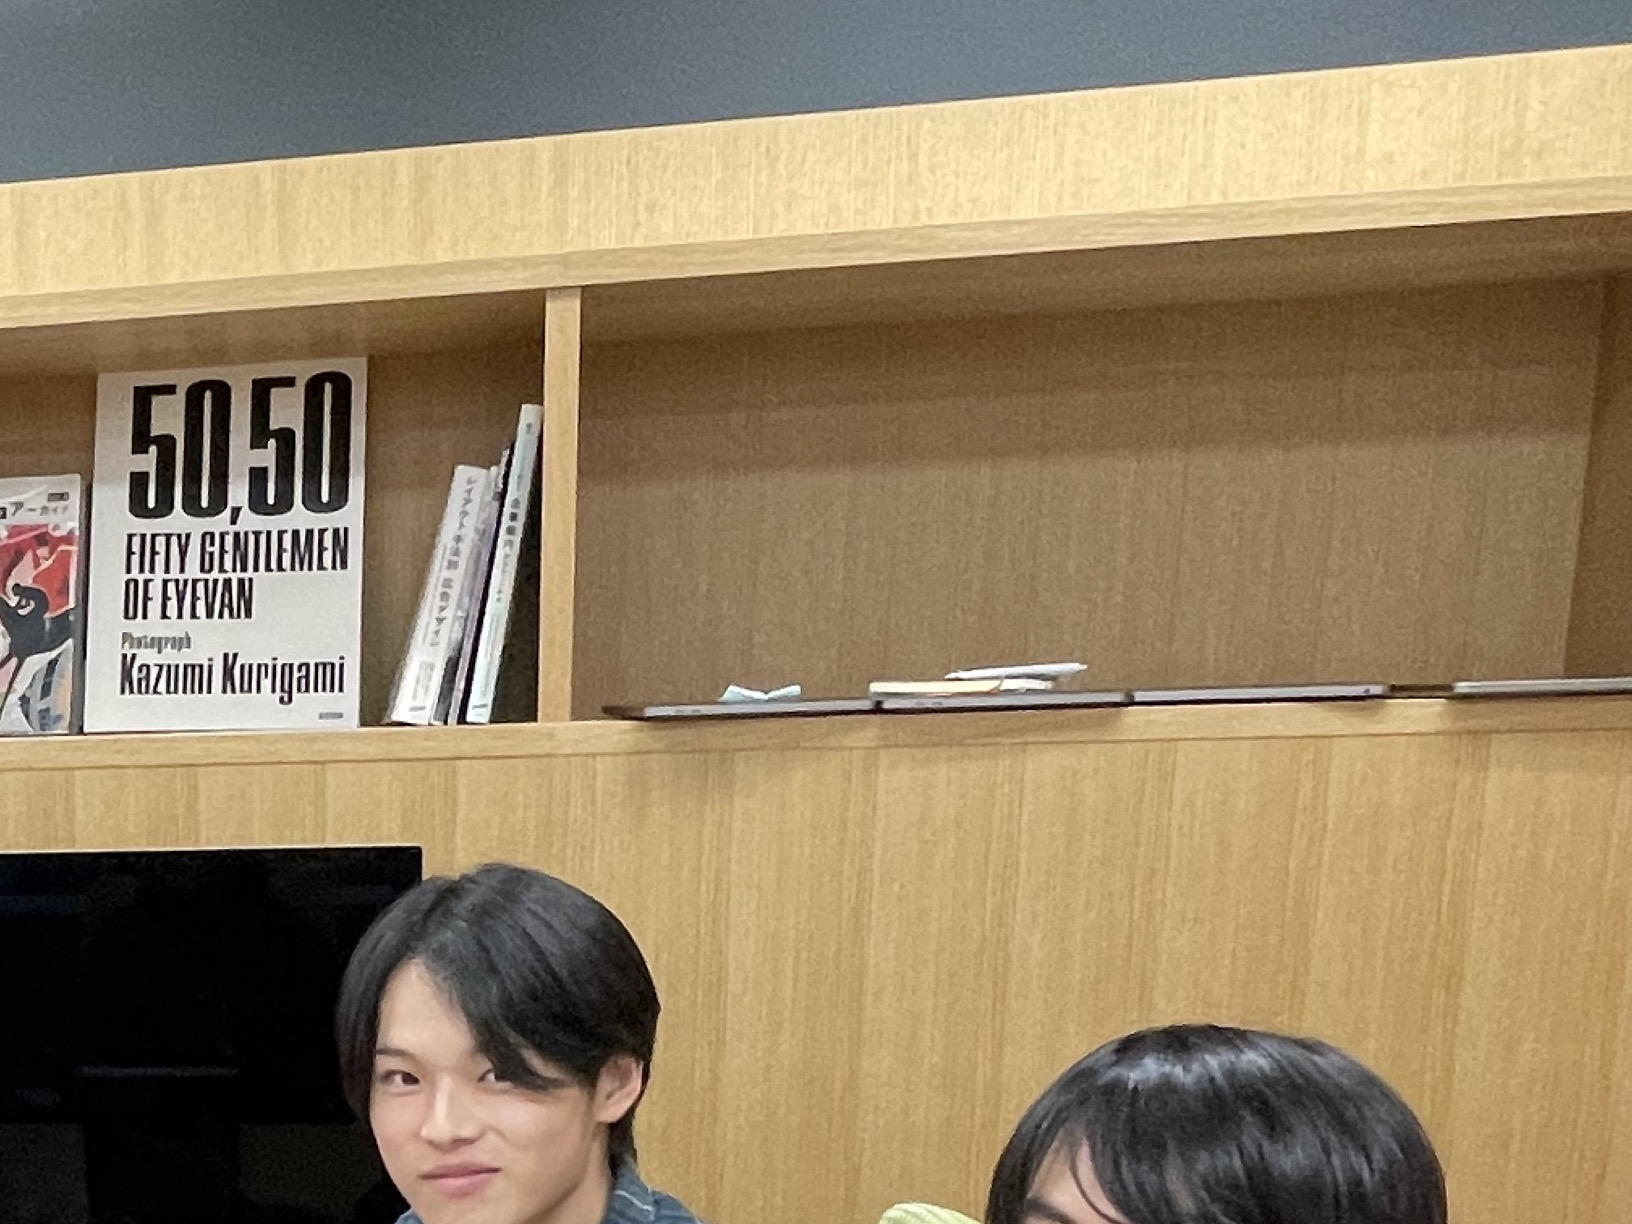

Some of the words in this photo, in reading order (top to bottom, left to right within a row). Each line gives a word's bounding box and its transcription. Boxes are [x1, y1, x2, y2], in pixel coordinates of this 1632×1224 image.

[128, 370, 353, 526] 50,50
[124, 531, 192, 575] FIFTY
[199, 527, 350, 573] GENTLEMEN
[122, 577, 154, 621] OF
[160, 576, 254, 621] EYEVAN
[120, 652, 214, 696] Kazumi
[221, 651, 346, 706] Kurigami
